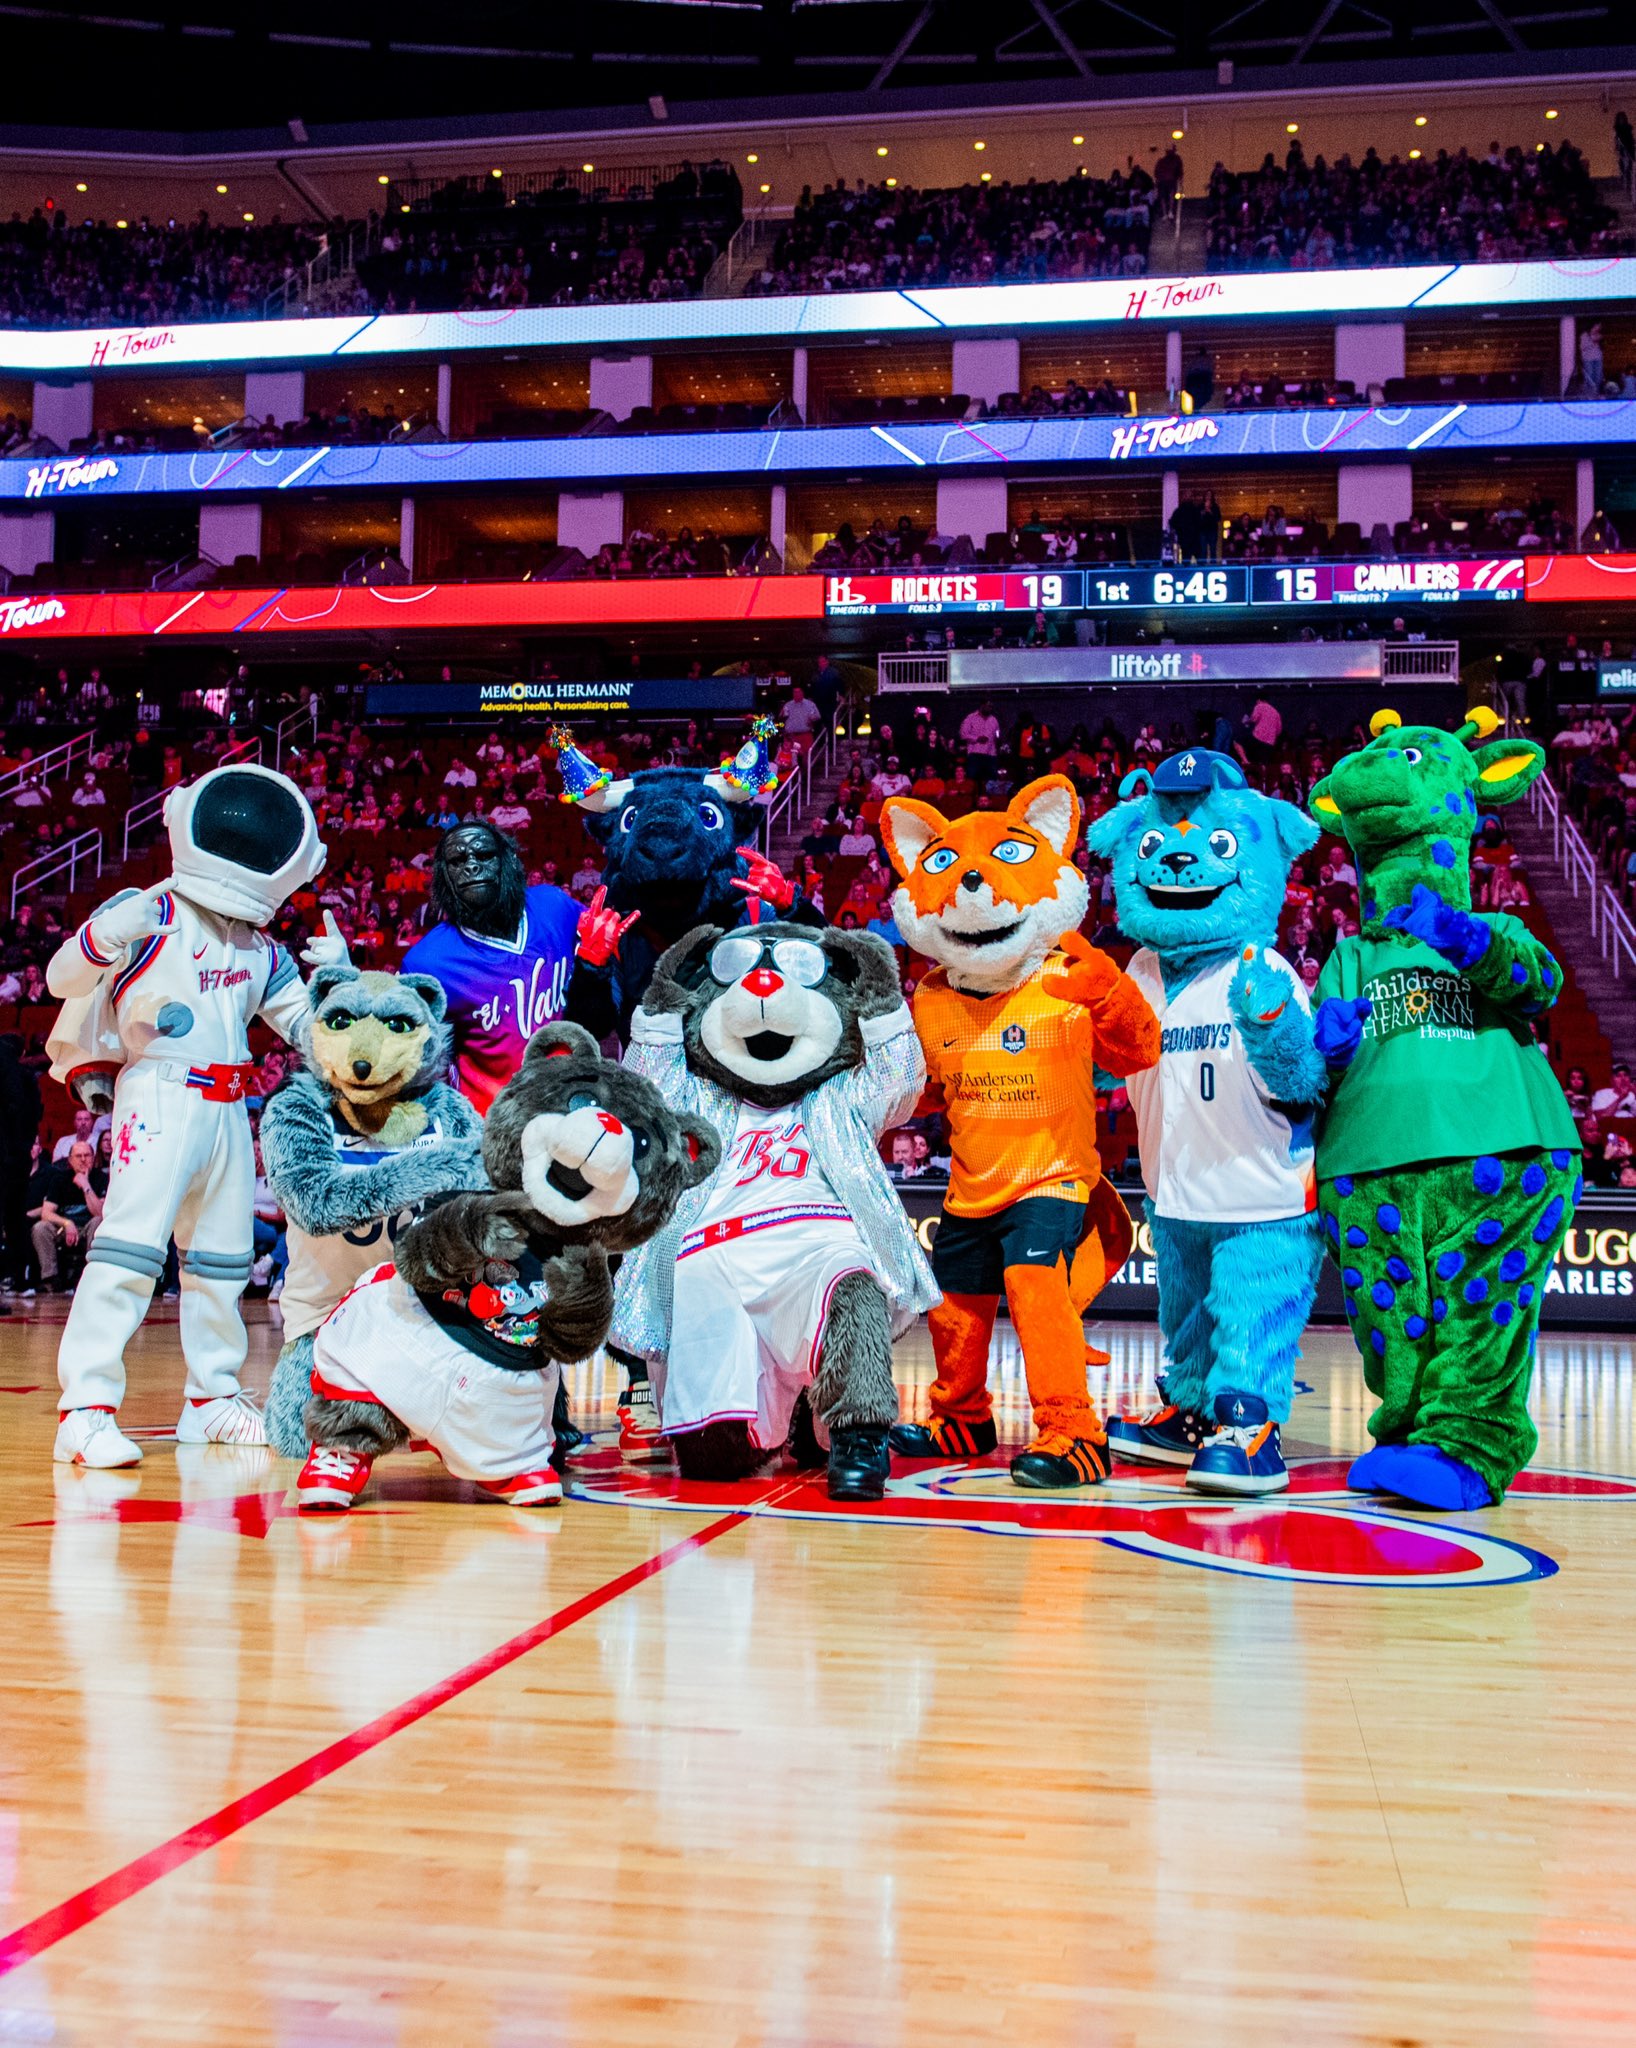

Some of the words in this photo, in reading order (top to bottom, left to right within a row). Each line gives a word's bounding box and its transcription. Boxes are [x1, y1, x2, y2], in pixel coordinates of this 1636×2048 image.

[1126, 281, 1224, 320] H-Town
[89, 331, 176, 367] H-Town
[1109, 416, 1219, 460] H-Town
[26, 457, 119, 498] H-Town
[891, 576, 977, 602] ROCKETS
[1022, 575, 1062, 607] 19
[1096, 581, 1130, 601] 1st
[1153, 571, 1228, 603] 6:46
[1275, 568, 1317, 601] 15
[1354, 564, 1460, 591] CAVALIERS
[0, 597, 66, 632] Town
[1111, 653, 1182, 678] liftoff
[480, 682, 554, 700] MEMORIAL
[556, 683, 631, 697] HERMANN
[480, 702, 523, 712] Advancing
[524, 701, 552, 711] health.
[554, 701, 609, 711] Personalizing
[610, 701, 630, 710] care.
[198, 967, 253, 993] H-Town
[1362, 971, 1471, 1001] Children's
[472, 995, 500, 1031] El
[509, 956, 568, 1039] Vall
[1160, 1023, 1231, 1054] COWBOYS
[1362, 1008, 1474, 1039] HERMANN
[1420, 1025, 1475, 1041] Hospital
[964, 1071, 1034, 1087] Anderson
[987, 1088, 1040, 1102] Center.
[1554, 1228, 1636, 1266] UG
